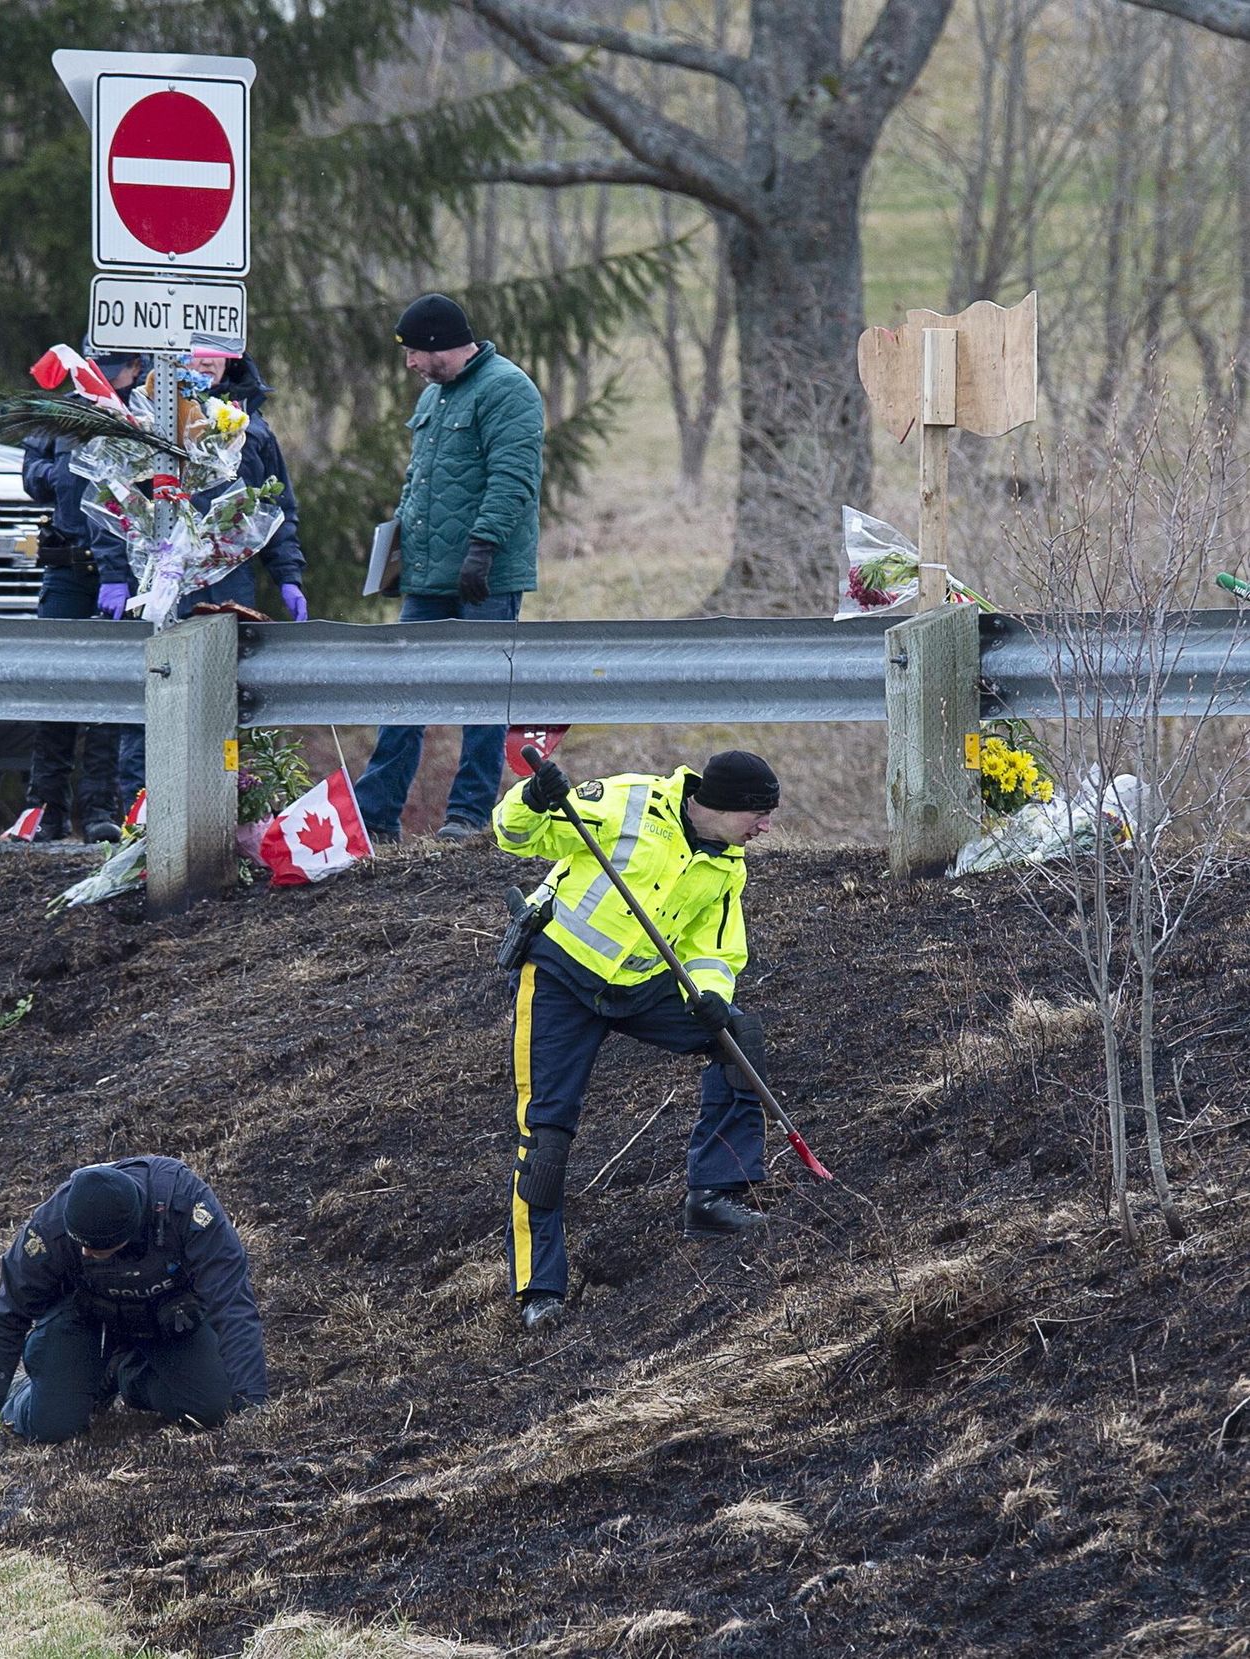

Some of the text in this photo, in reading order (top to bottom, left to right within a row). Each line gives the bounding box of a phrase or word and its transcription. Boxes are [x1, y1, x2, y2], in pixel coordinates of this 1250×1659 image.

[98, 300, 239, 332] DO NOT ENTER
[644, 822, 674, 841] POLICE
[109, 1278, 174, 1298] POLICE
